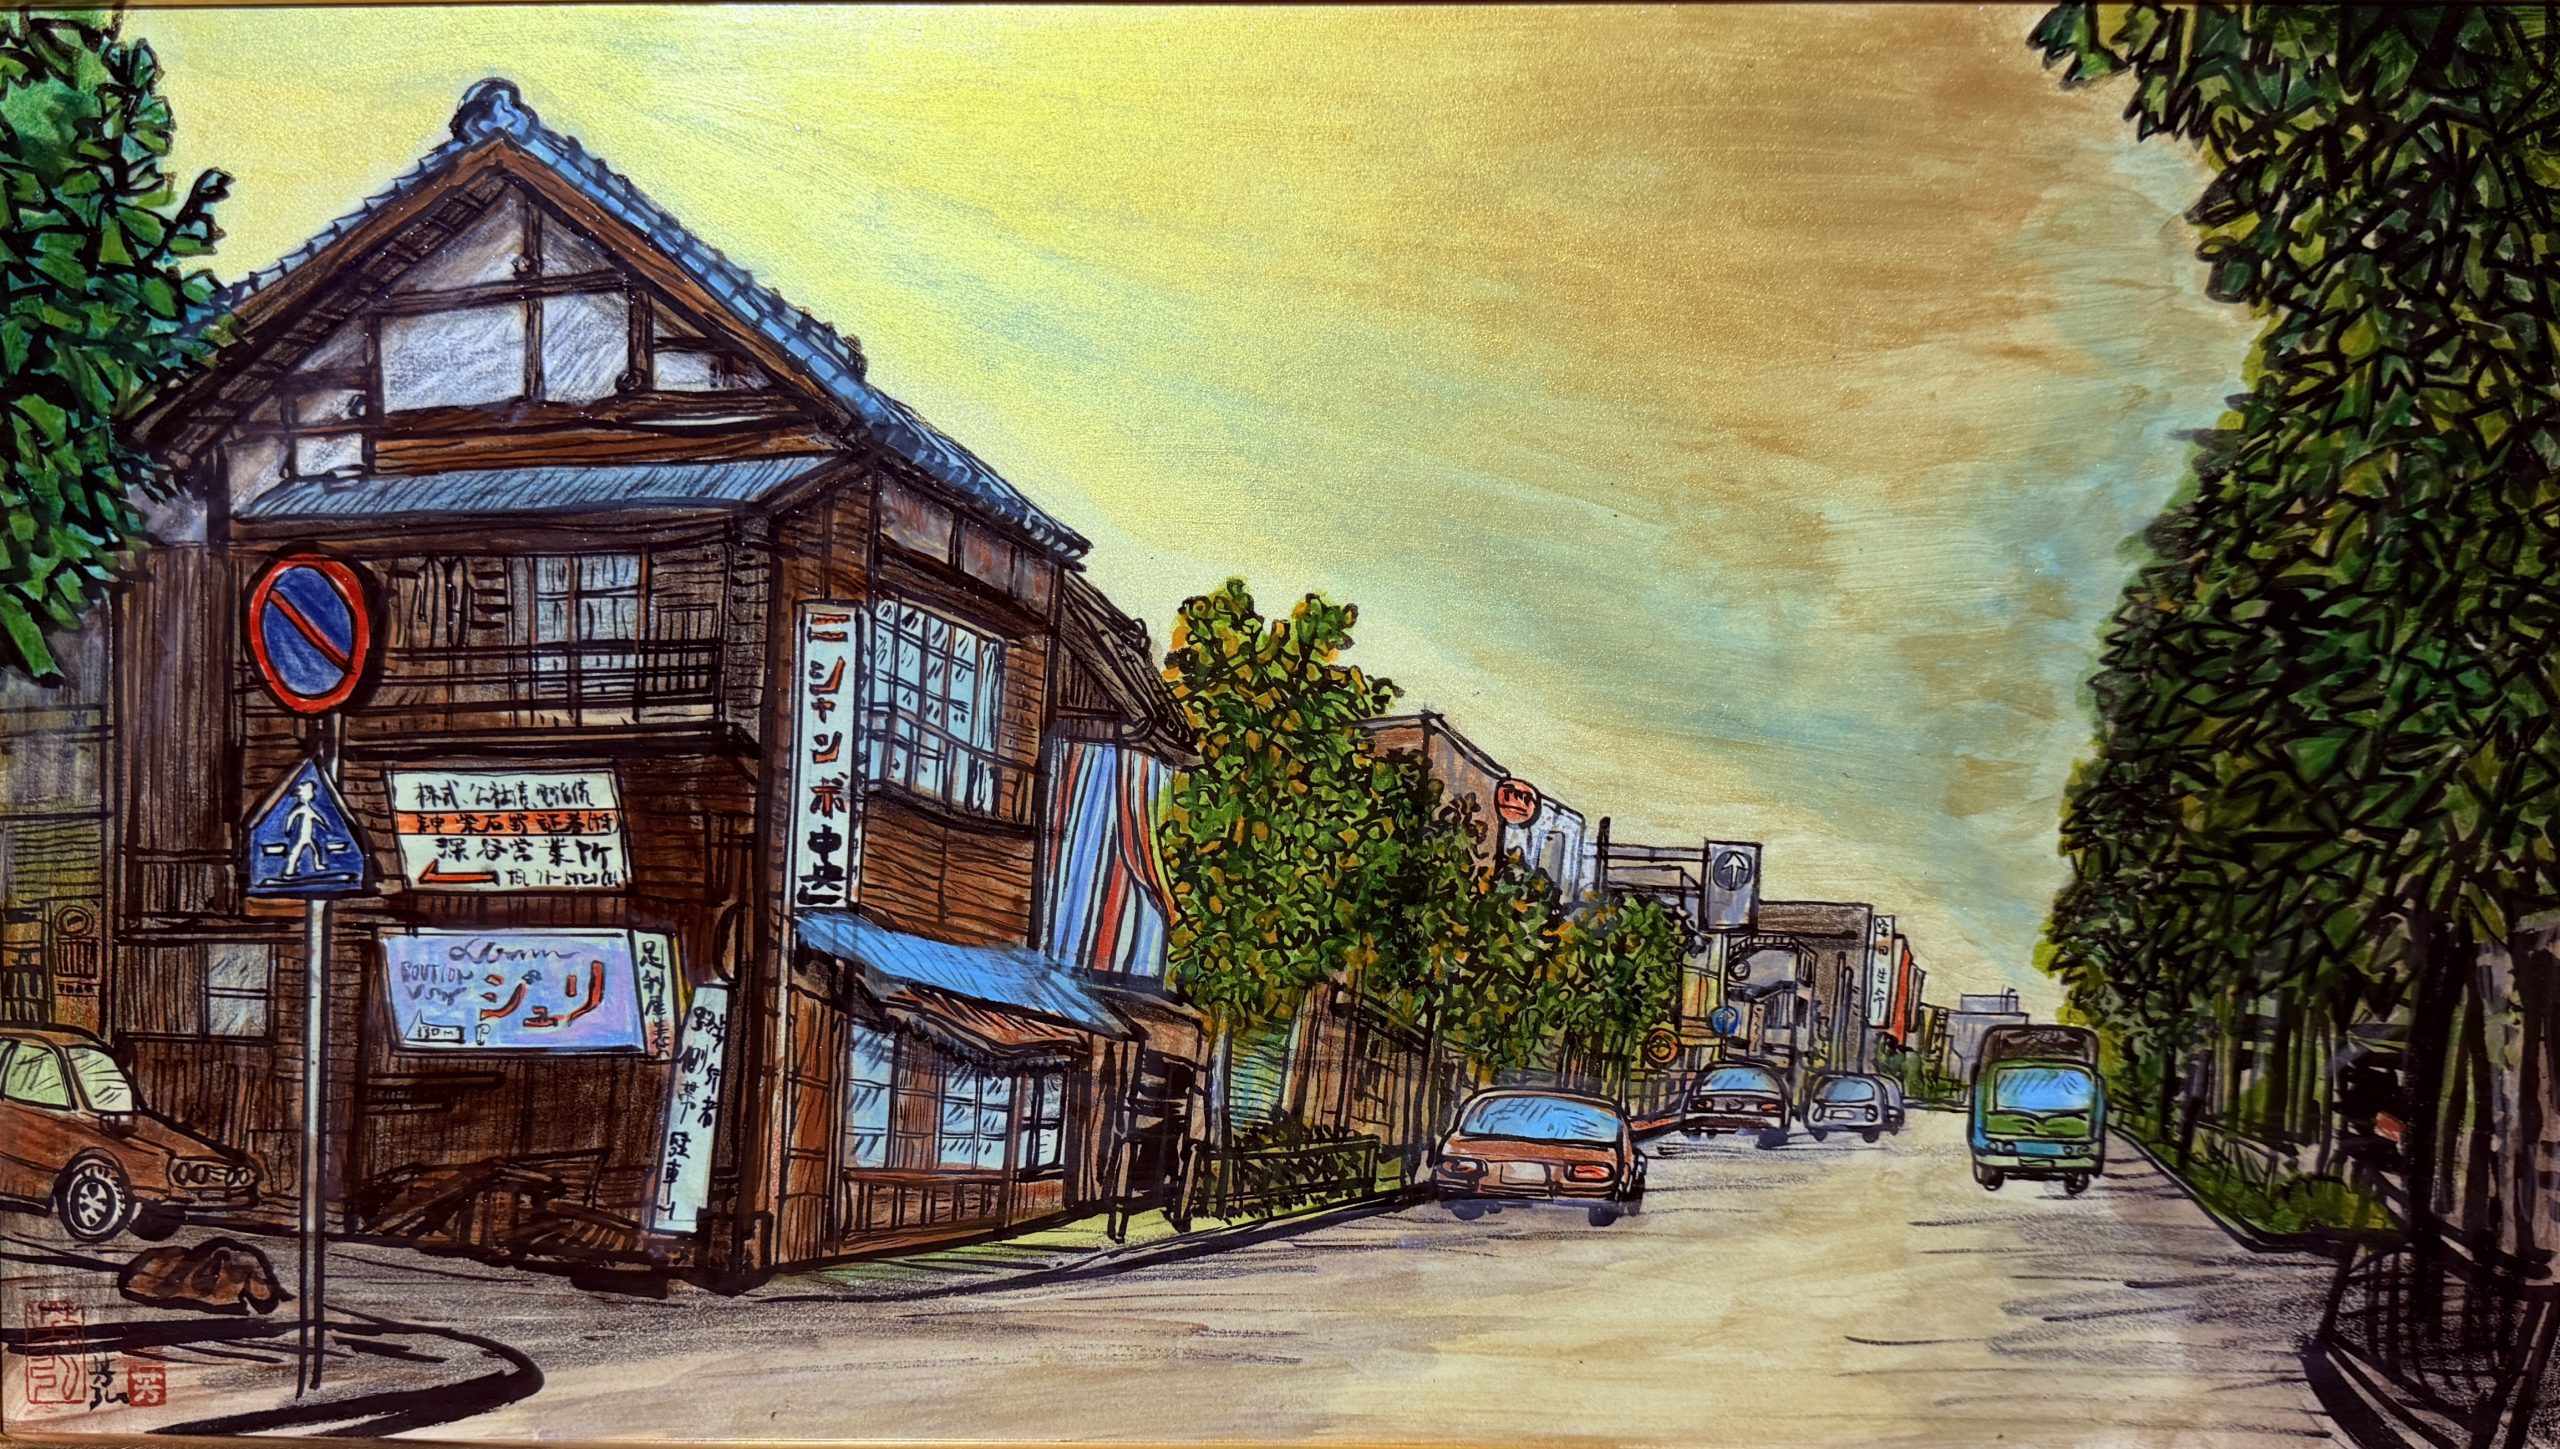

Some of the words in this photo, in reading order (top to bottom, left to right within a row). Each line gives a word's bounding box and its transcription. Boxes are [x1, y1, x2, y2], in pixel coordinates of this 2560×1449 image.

[435, 837, 613, 868] 深谷営業所
